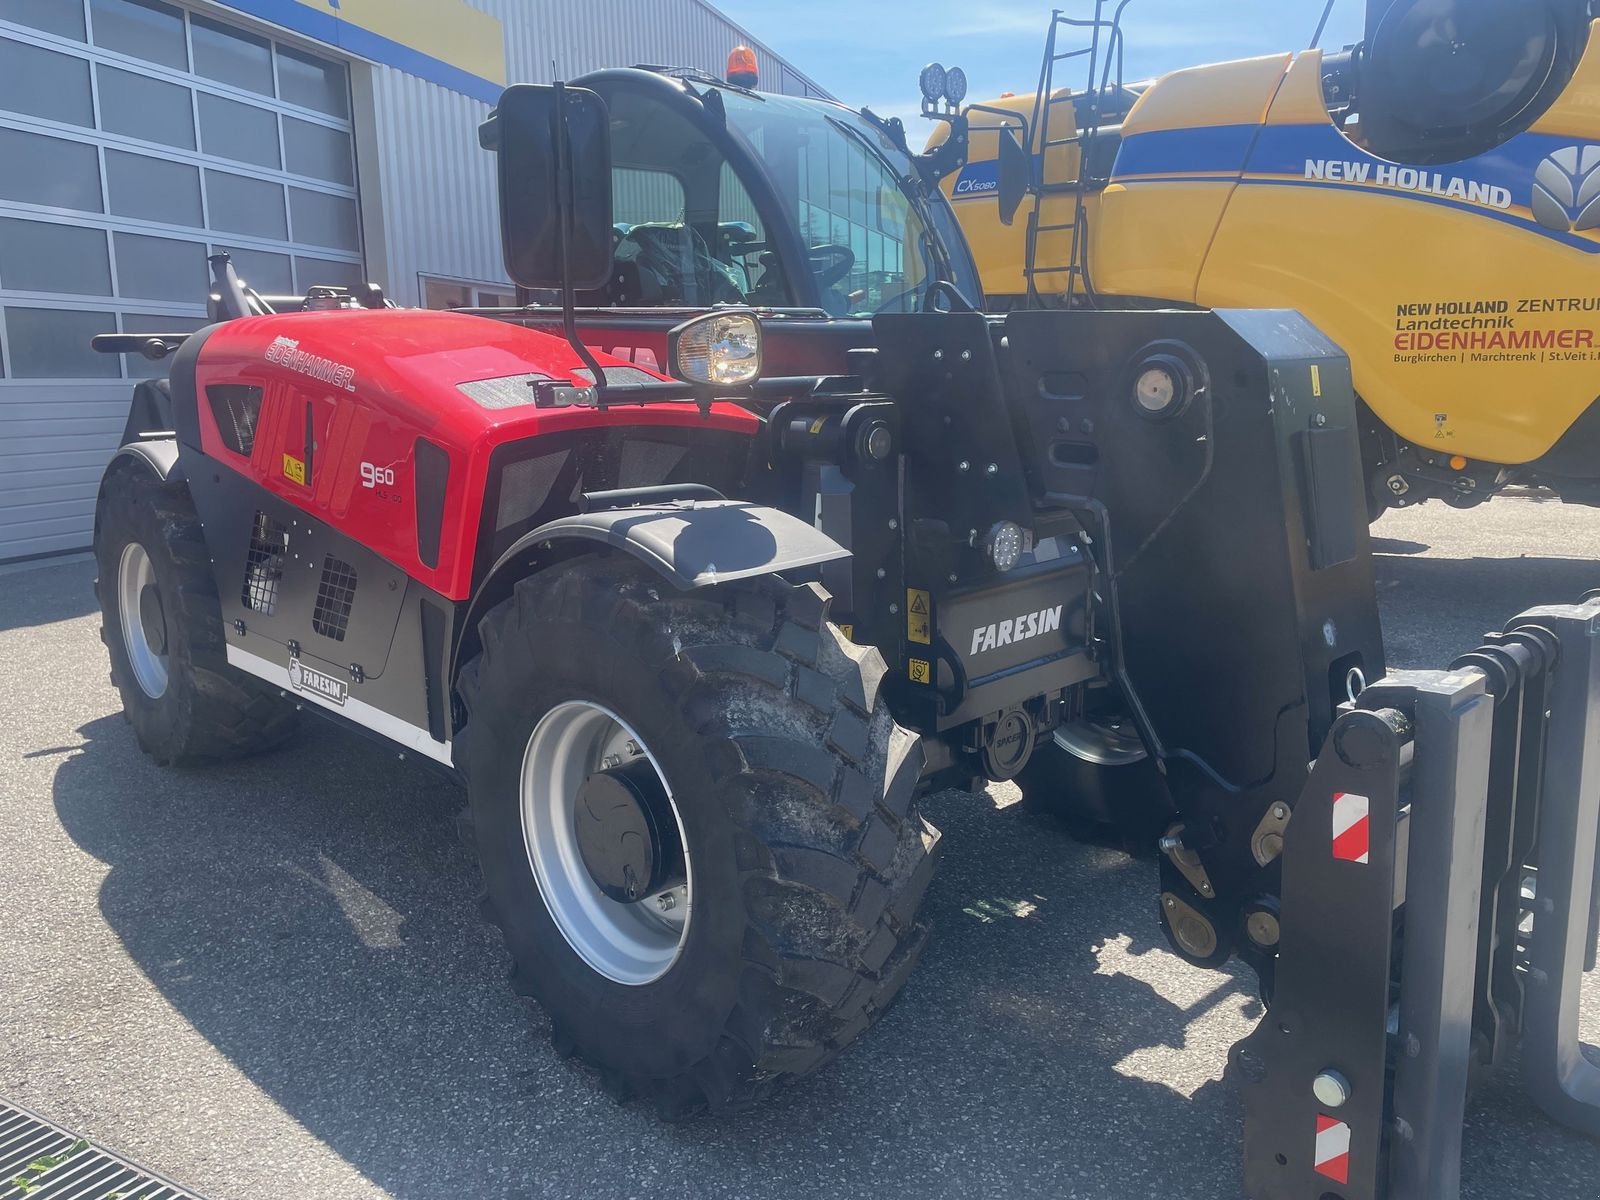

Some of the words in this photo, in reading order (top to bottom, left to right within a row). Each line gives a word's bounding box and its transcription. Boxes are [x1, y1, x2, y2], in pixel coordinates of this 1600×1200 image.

[1304, 159, 1370, 183] NEW
[1376, 164, 1512, 209] HOLLAND
[1396, 303, 1432, 317] NEW
[1435, 300, 1508, 315] HOLLAND
[1516, 297, 1600, 313] ZENTRU
[1396, 316, 1514, 331] Landtechnik
[1394, 329, 1594, 351] EIDENHAMMER
[1393, 353, 1457, 364] Burgkirchen
[1470, 352, 1536, 363] Marchtrenk
[1548, 351, 1587, 362] St.Veit
[360, 461, 394, 488] 960
[969, 604, 1063, 656] FARESIN
[303, 669, 341, 698] FARESIN
